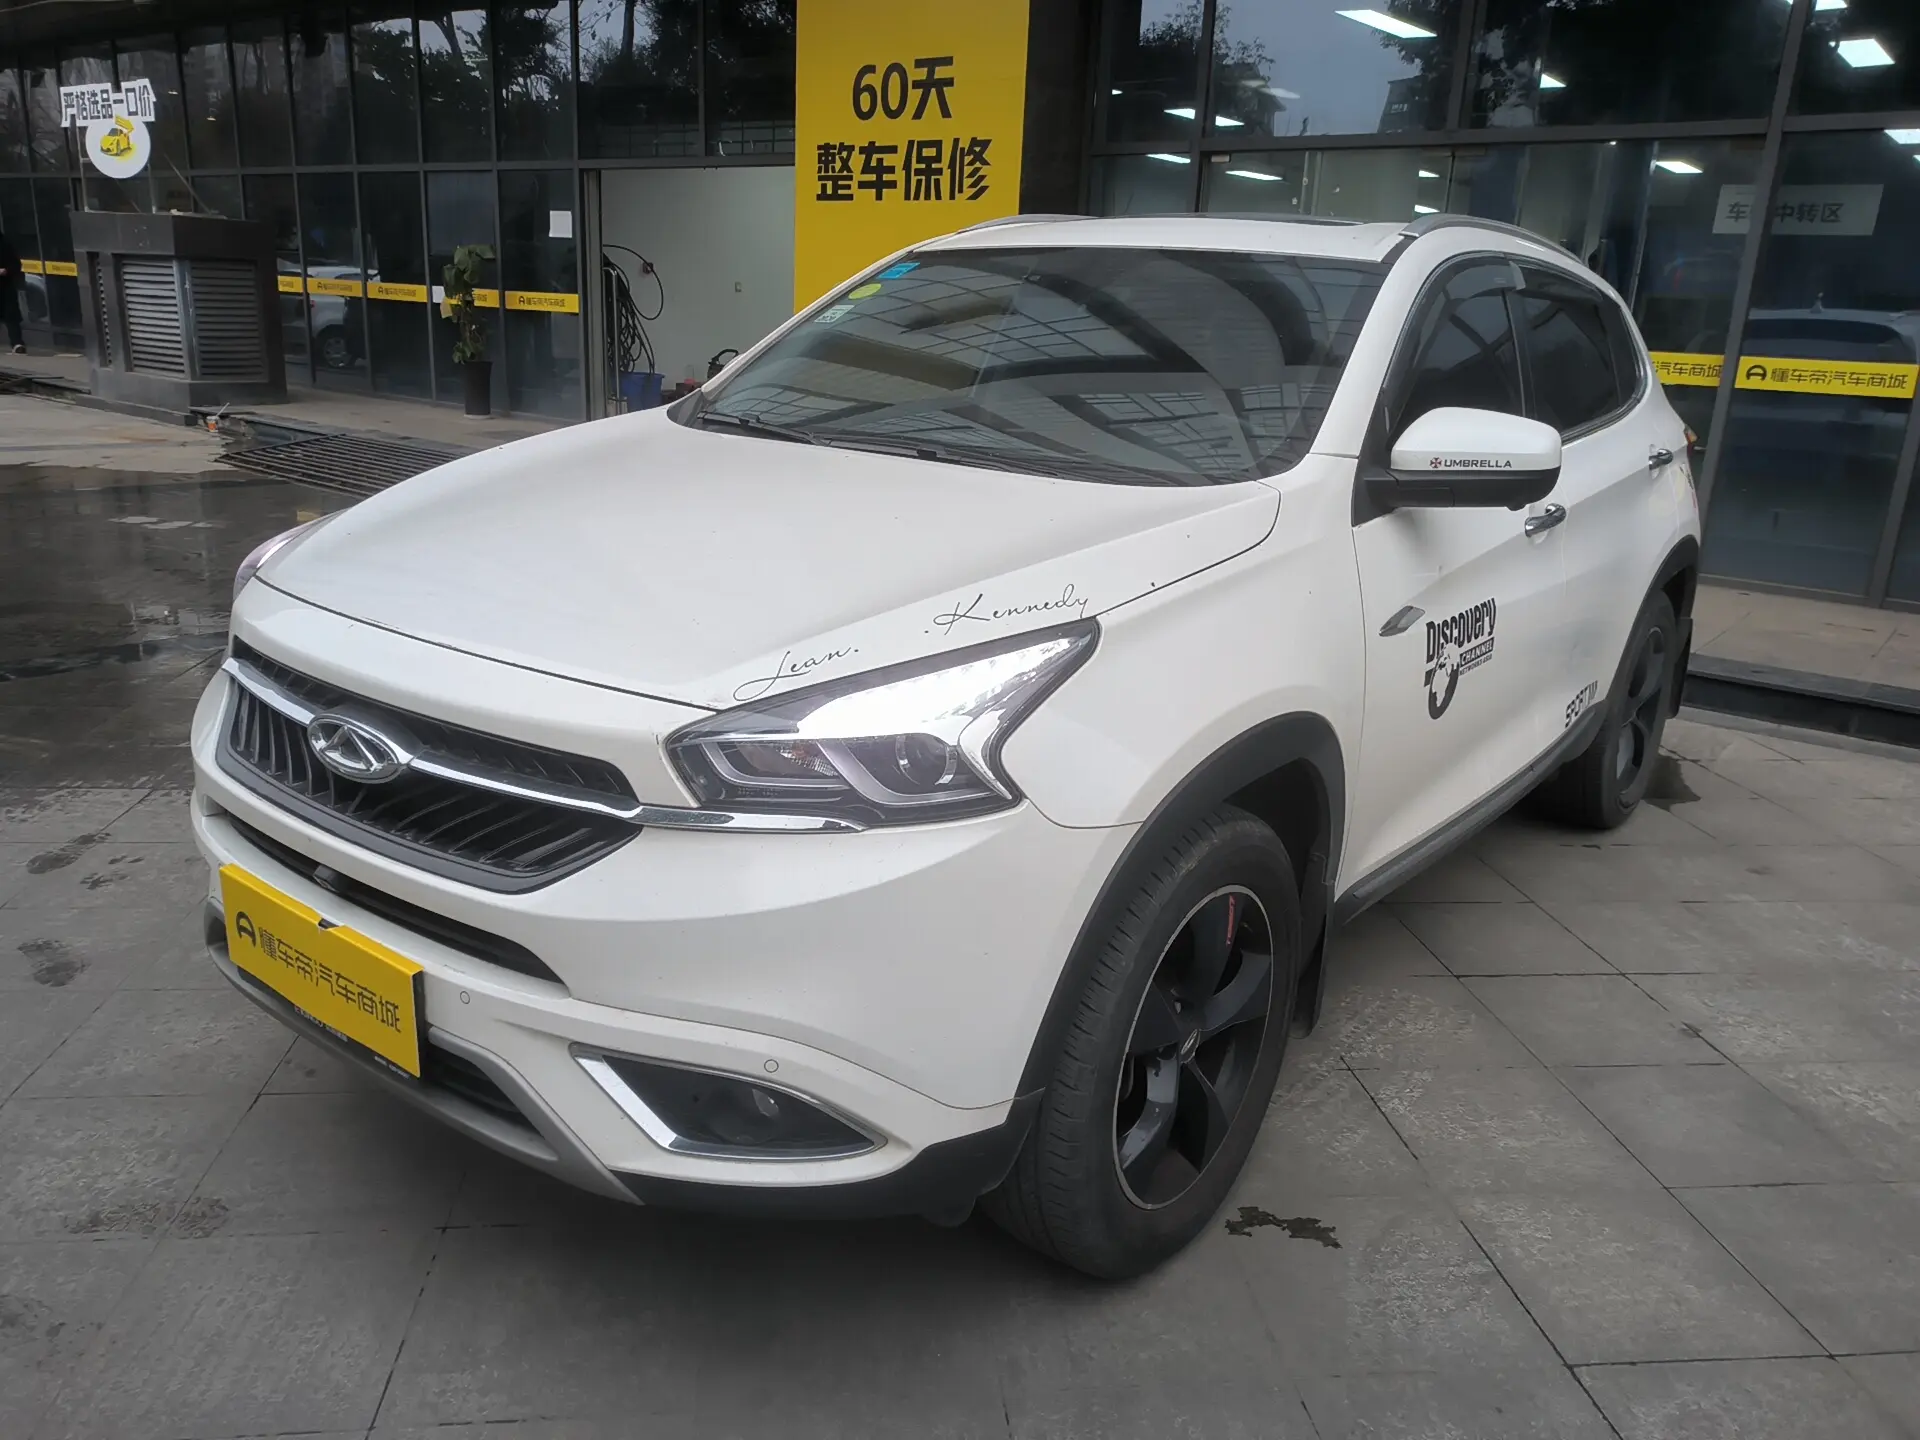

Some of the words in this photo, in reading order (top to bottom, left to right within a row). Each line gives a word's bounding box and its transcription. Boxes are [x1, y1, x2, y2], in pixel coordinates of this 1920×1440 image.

[63, 85, 152, 121] 严格选品一口价
[852, 56, 954, 120] 60天
[816, 137, 992, 201] 整车保修
[1726, 201, 1844, 223] 车中转区
[1770, 367, 1909, 390] 懂车帝汽车商城
[1444, 459, 1512, 468] UMBRELLA
[1460, 637, 1494, 668] CHANNEL
[259, 926, 402, 1033] 懂车帝汽车商城
